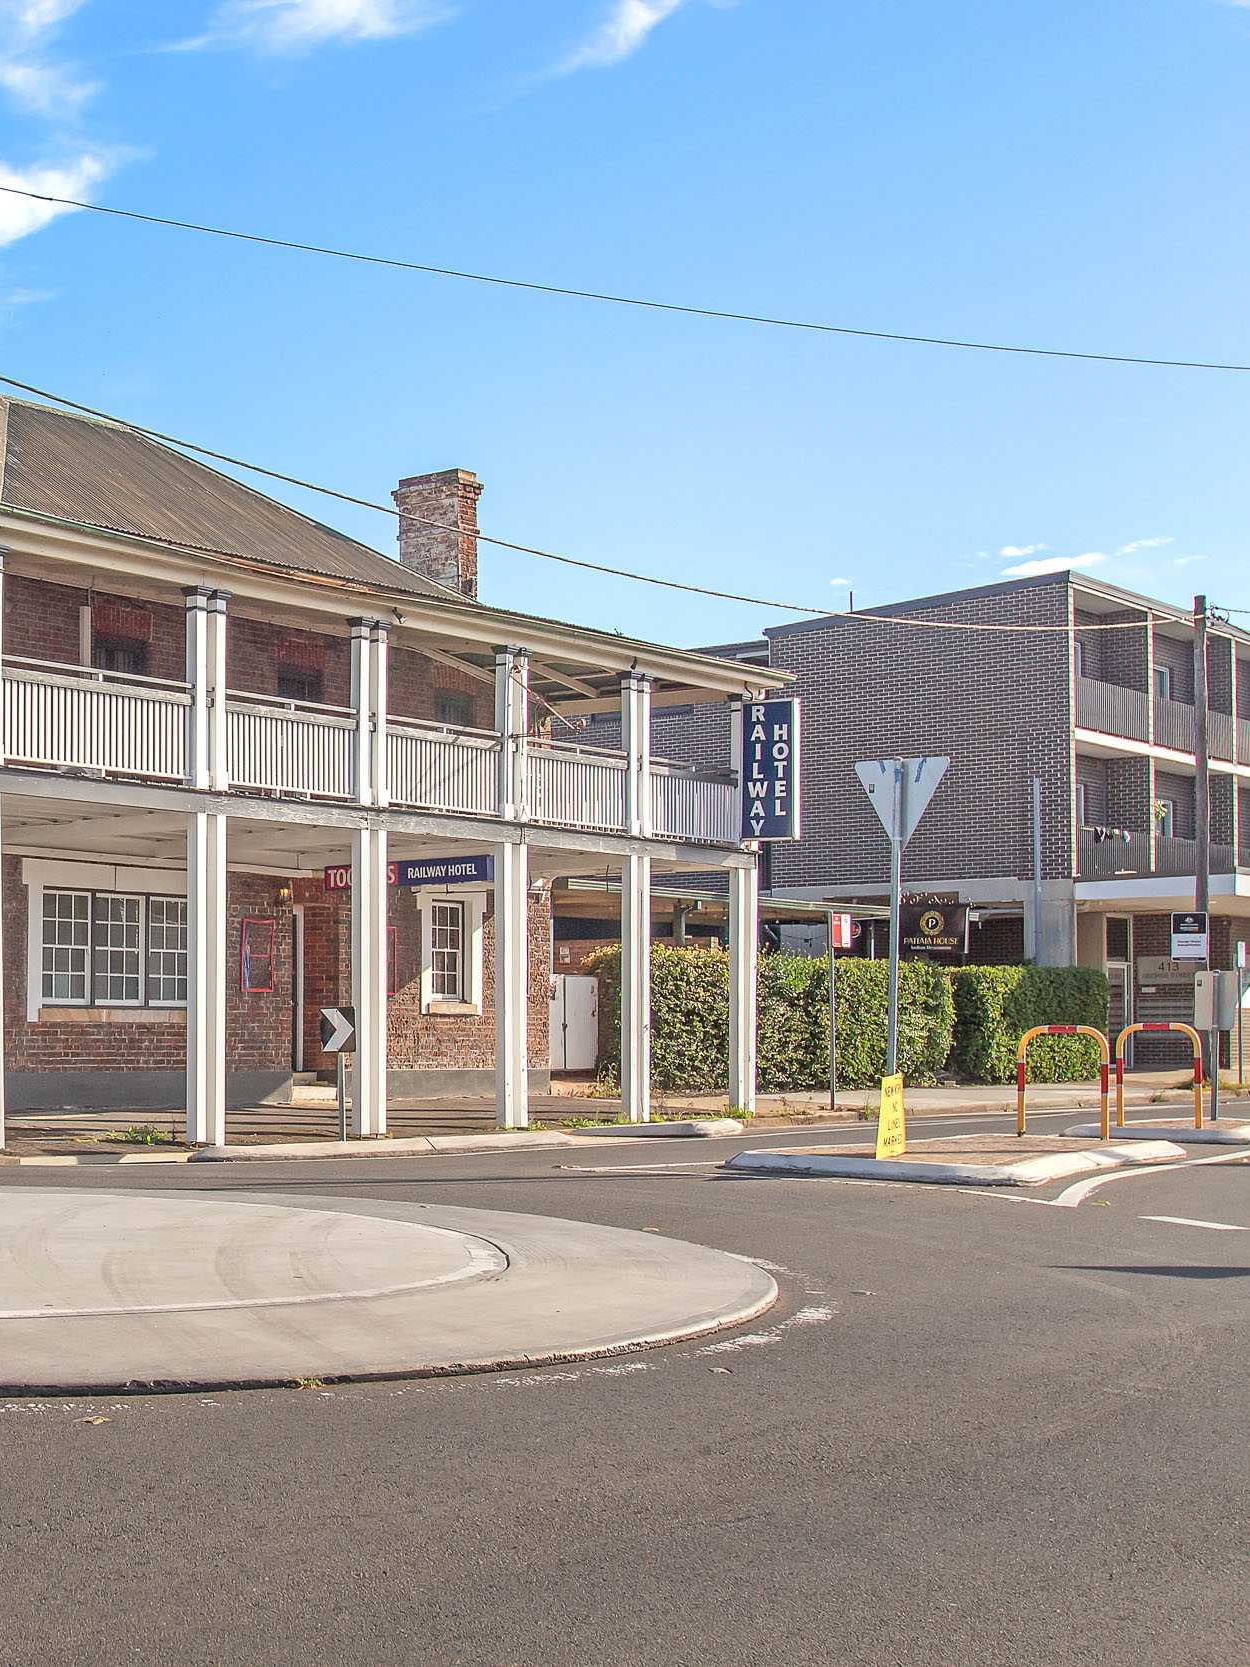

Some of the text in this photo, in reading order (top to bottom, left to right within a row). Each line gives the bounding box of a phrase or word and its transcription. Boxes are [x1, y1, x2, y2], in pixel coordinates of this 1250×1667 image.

[747, 705, 768, 836] RAILWAY
[772, 724, 789, 816] HOTEL
[407, 863, 478, 880] RAILWAY HOTEL
[928, 918, 937, 929] P
[933, 937, 958, 945] HOUSE
[1158, 961, 1179, 971] 413
